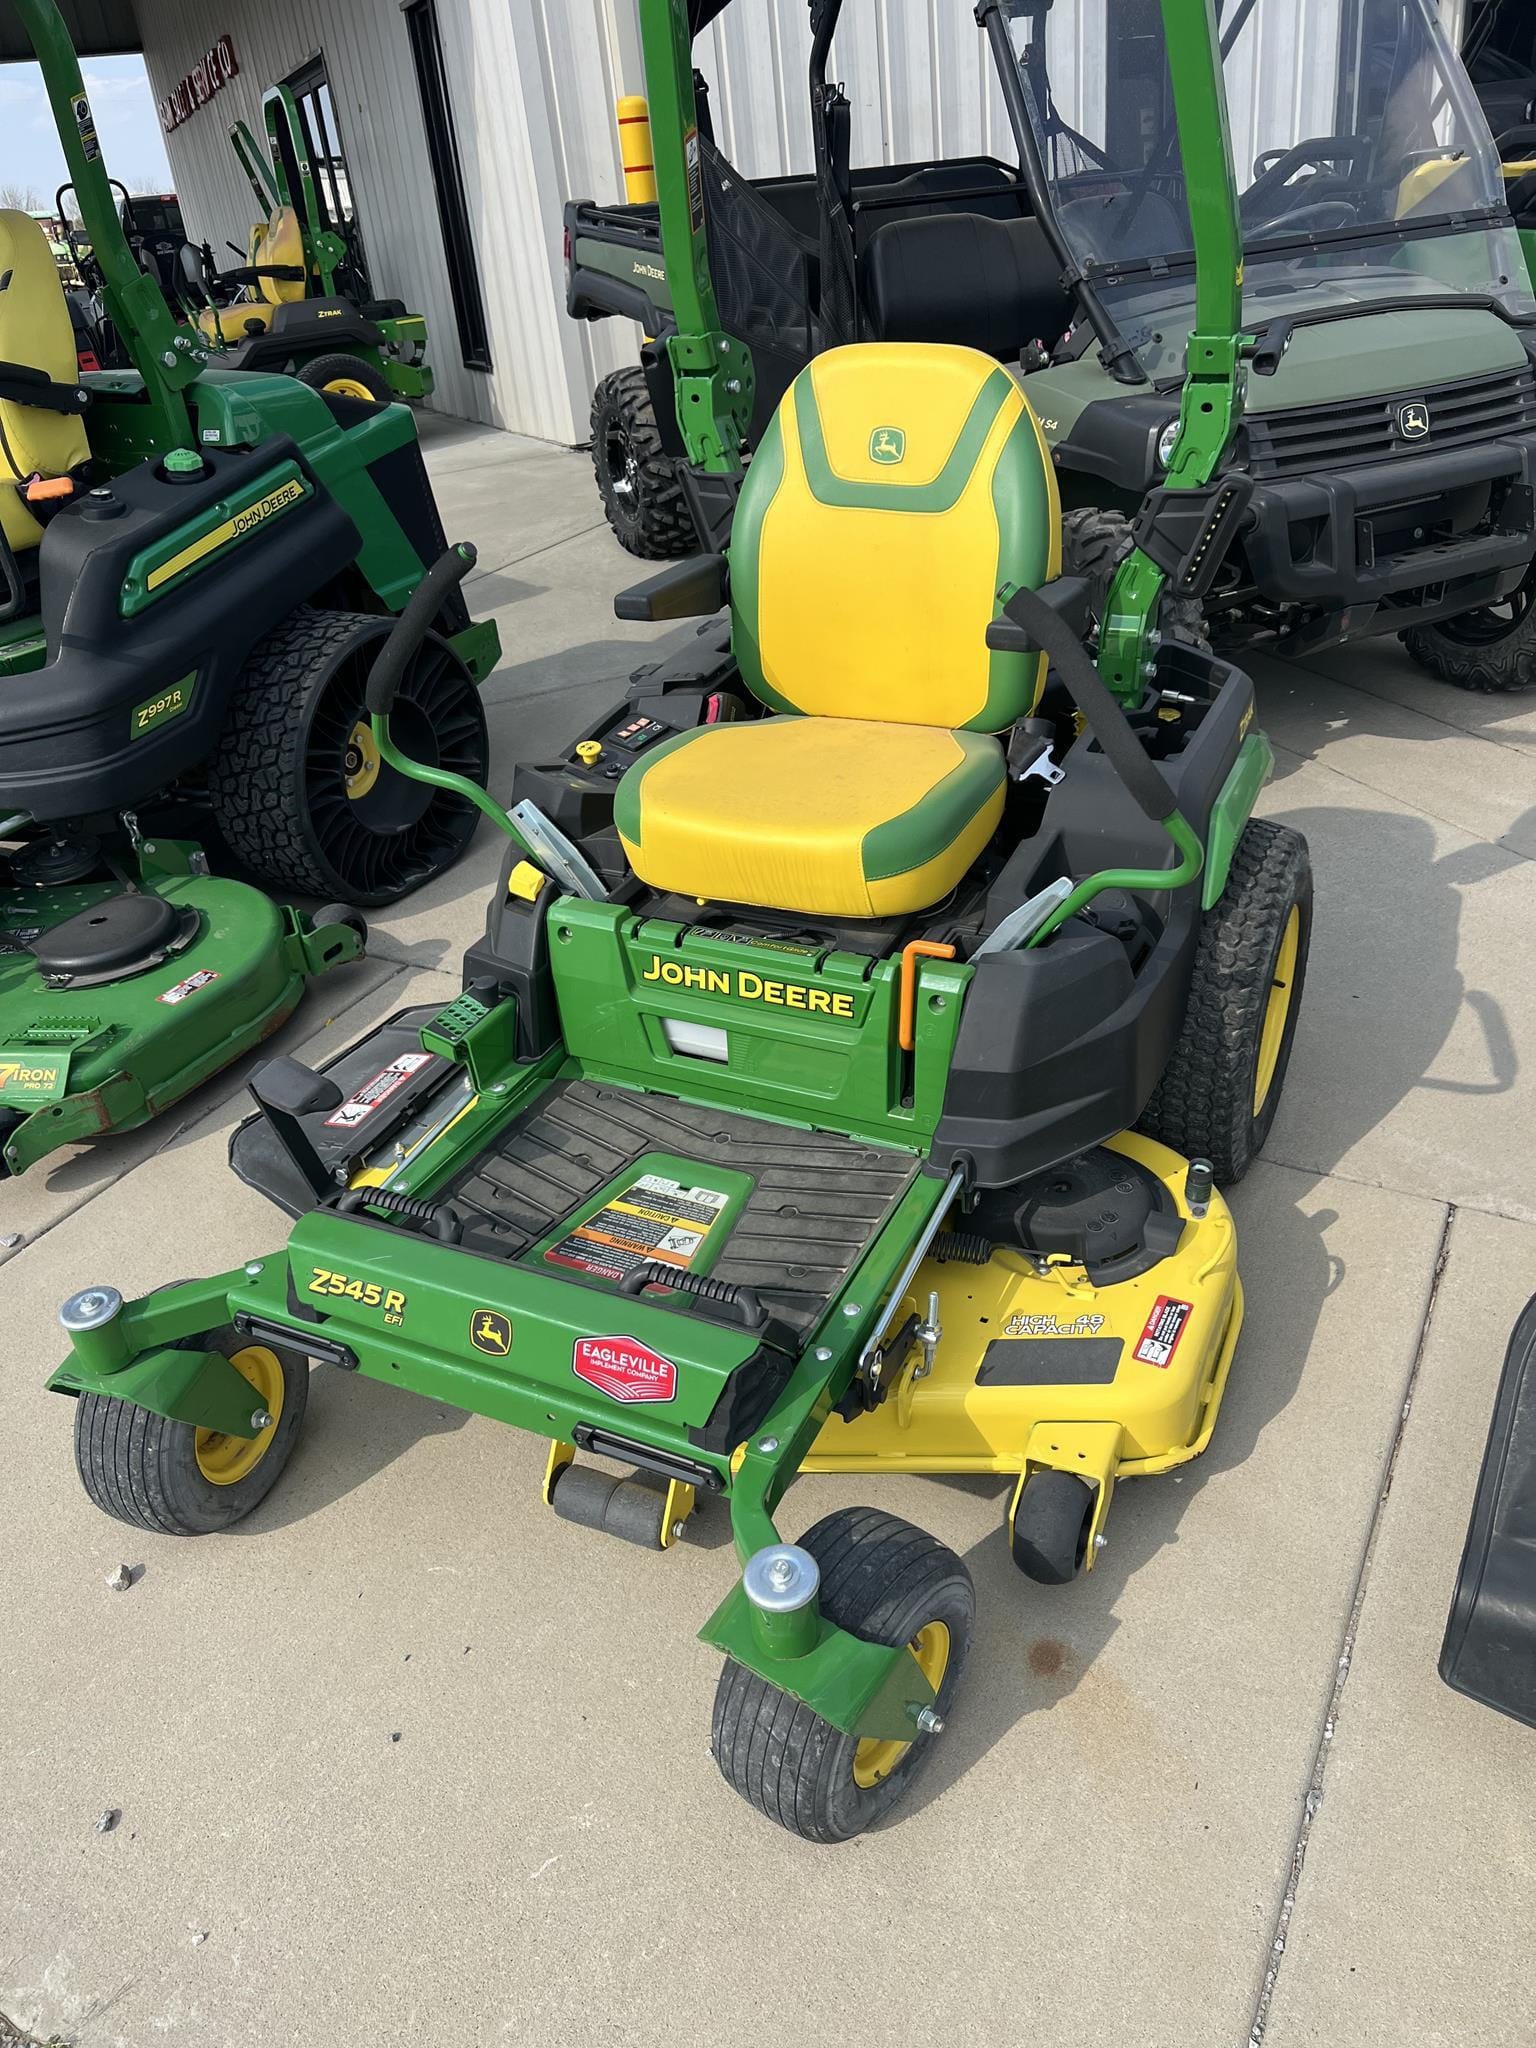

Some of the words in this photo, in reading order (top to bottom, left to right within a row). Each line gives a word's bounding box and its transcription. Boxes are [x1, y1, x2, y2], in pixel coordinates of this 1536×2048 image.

[633, 261, 647, 275] JOHN
[647, 264, 666, 281] DEERE
[317, 309, 342, 318] ZTRAK
[1044, 419, 1058, 431] S4
[232, 507, 262, 537] JOHN
[261, 486, 298, 515] DEERE
[643, 955, 731, 995] JOHN
[737, 970, 854, 1018] DEERE
[639, 1208, 671, 1223] CAUTION
[609, 1236, 644, 1251] WARNING
[585, 1264, 619, 1279] DANGER
[384, 1313, 404, 1327] EFI
[1011, 1314, 1057, 1326] HIGH
[1075, 1314, 1105, 1325] 48
[1005, 1324, 1101, 1335] CAPACITY
[582, 1343, 669, 1378] EAGLEVILLE
[590, 1358, 626, 1373] IMPLEMENT
[626, 1368, 659, 1382] COMPANY
